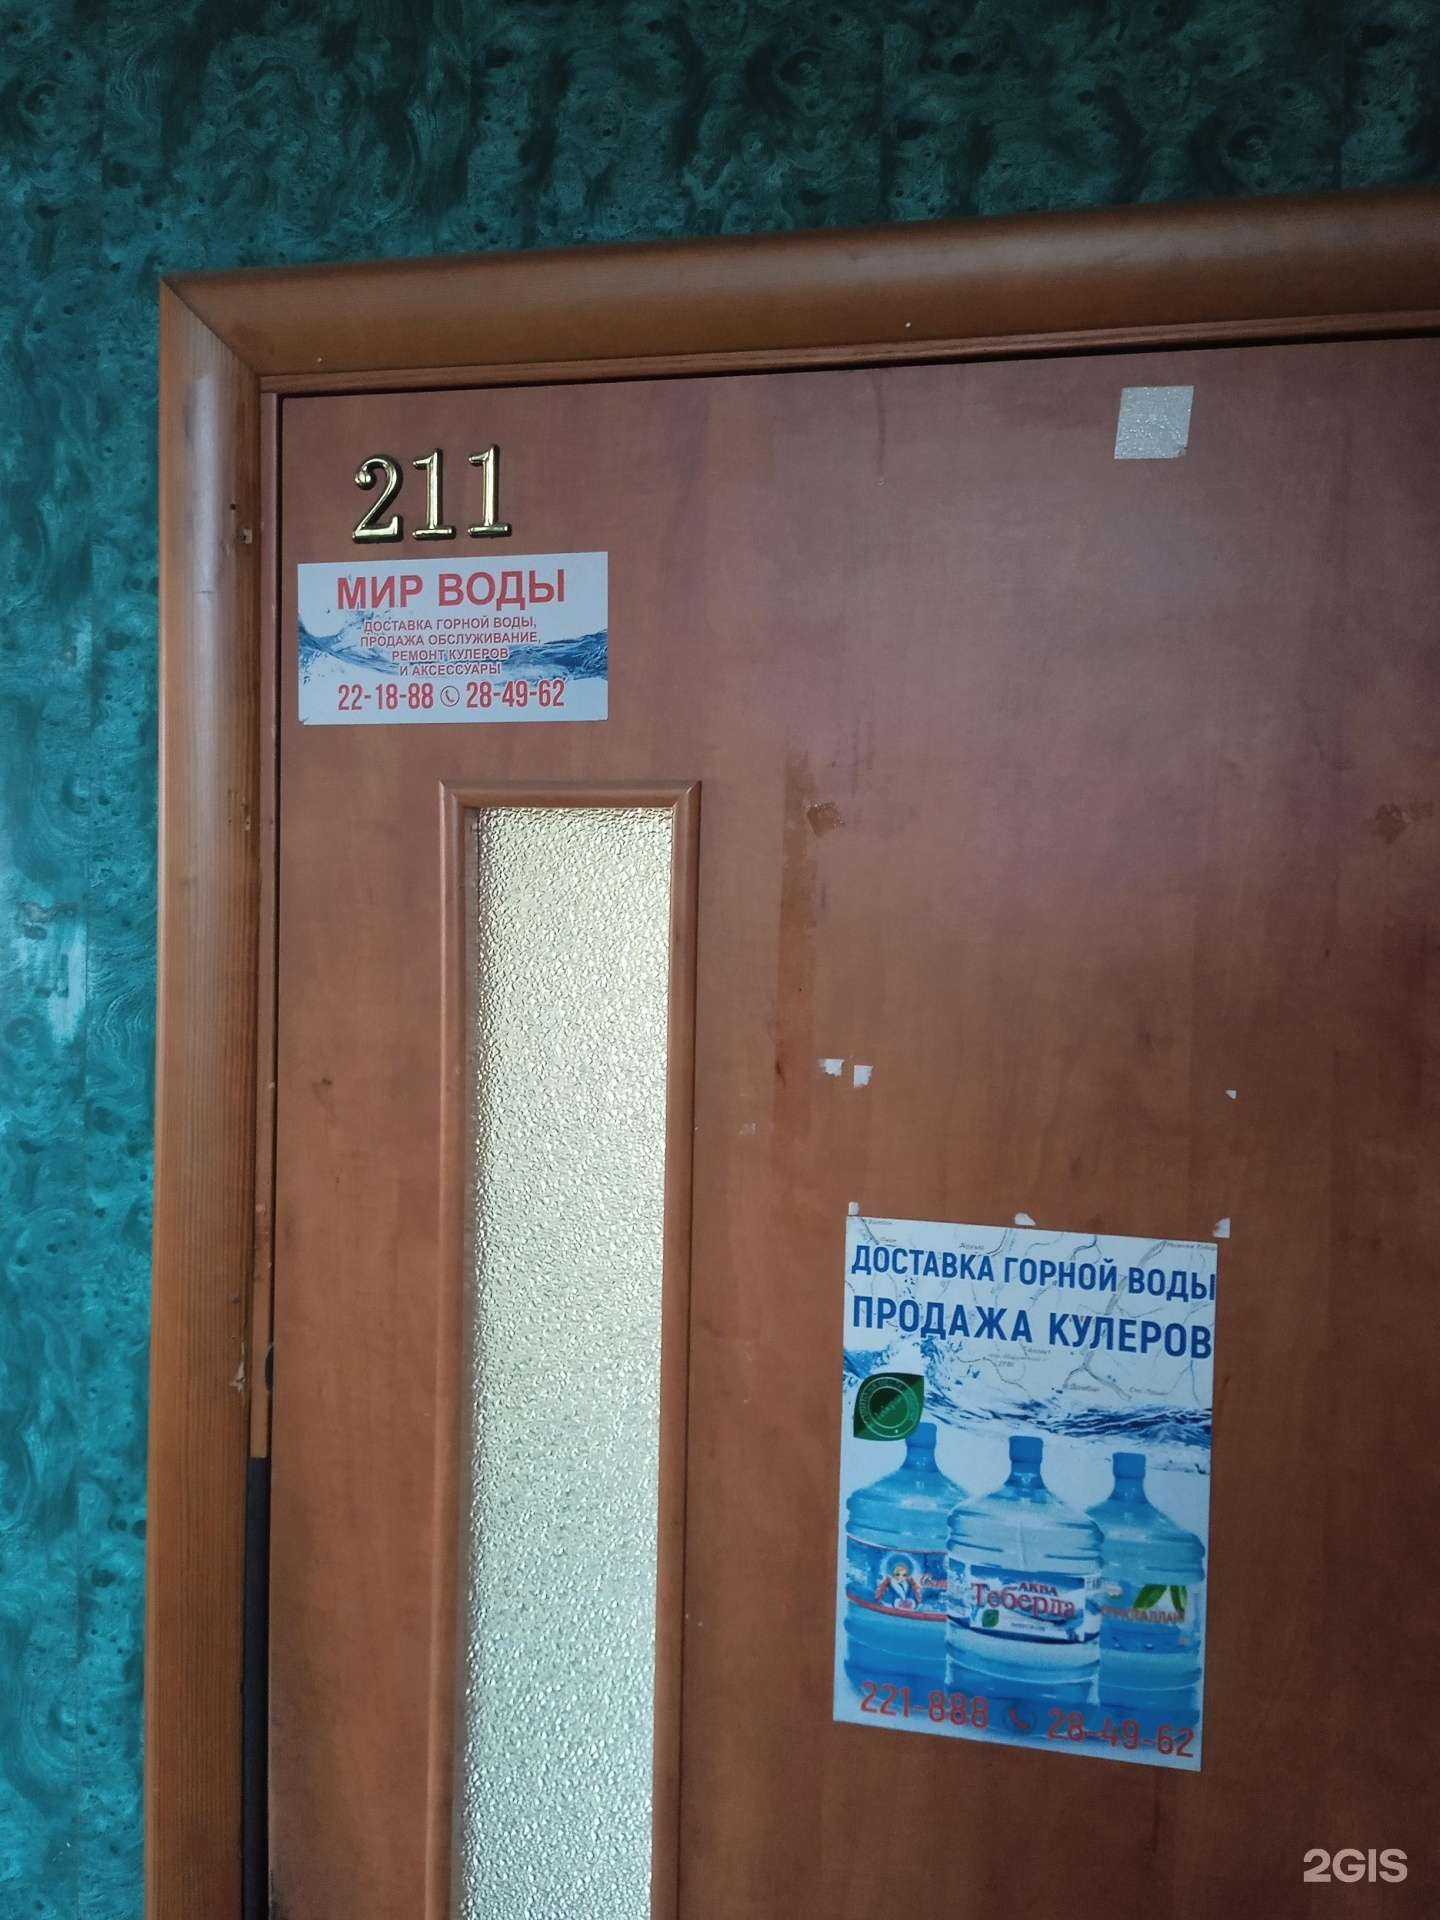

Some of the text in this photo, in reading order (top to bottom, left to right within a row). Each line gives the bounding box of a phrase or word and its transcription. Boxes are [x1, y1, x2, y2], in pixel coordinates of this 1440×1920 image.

[352, 444, 512, 543] 211
[337, 569, 565, 611] МИР ВОДЫ
[360, 631, 541, 648] ПРОДАЖА ОБСЛУЖИВАНИЕ,
[364, 615, 537, 633] ДОСТАВКА ГОРНОЙ ВОДЫ,
[392, 647, 509, 662] РЕМОНТ КУЛЕРОВ
[400, 664, 501, 677] И АКСЕССУАРЫ
[338, 678, 566, 711] 22-18-88 28-49-62
[851, 1244, 1216, 1302] ДОСТАВКА ГОРНОЙ ВОДЫ
[853, 1295, 1212, 1360] ПРОДАЖА КУЛЕРОВ
[860, 1681, 1195, 1758] 221-888 28-49-62
